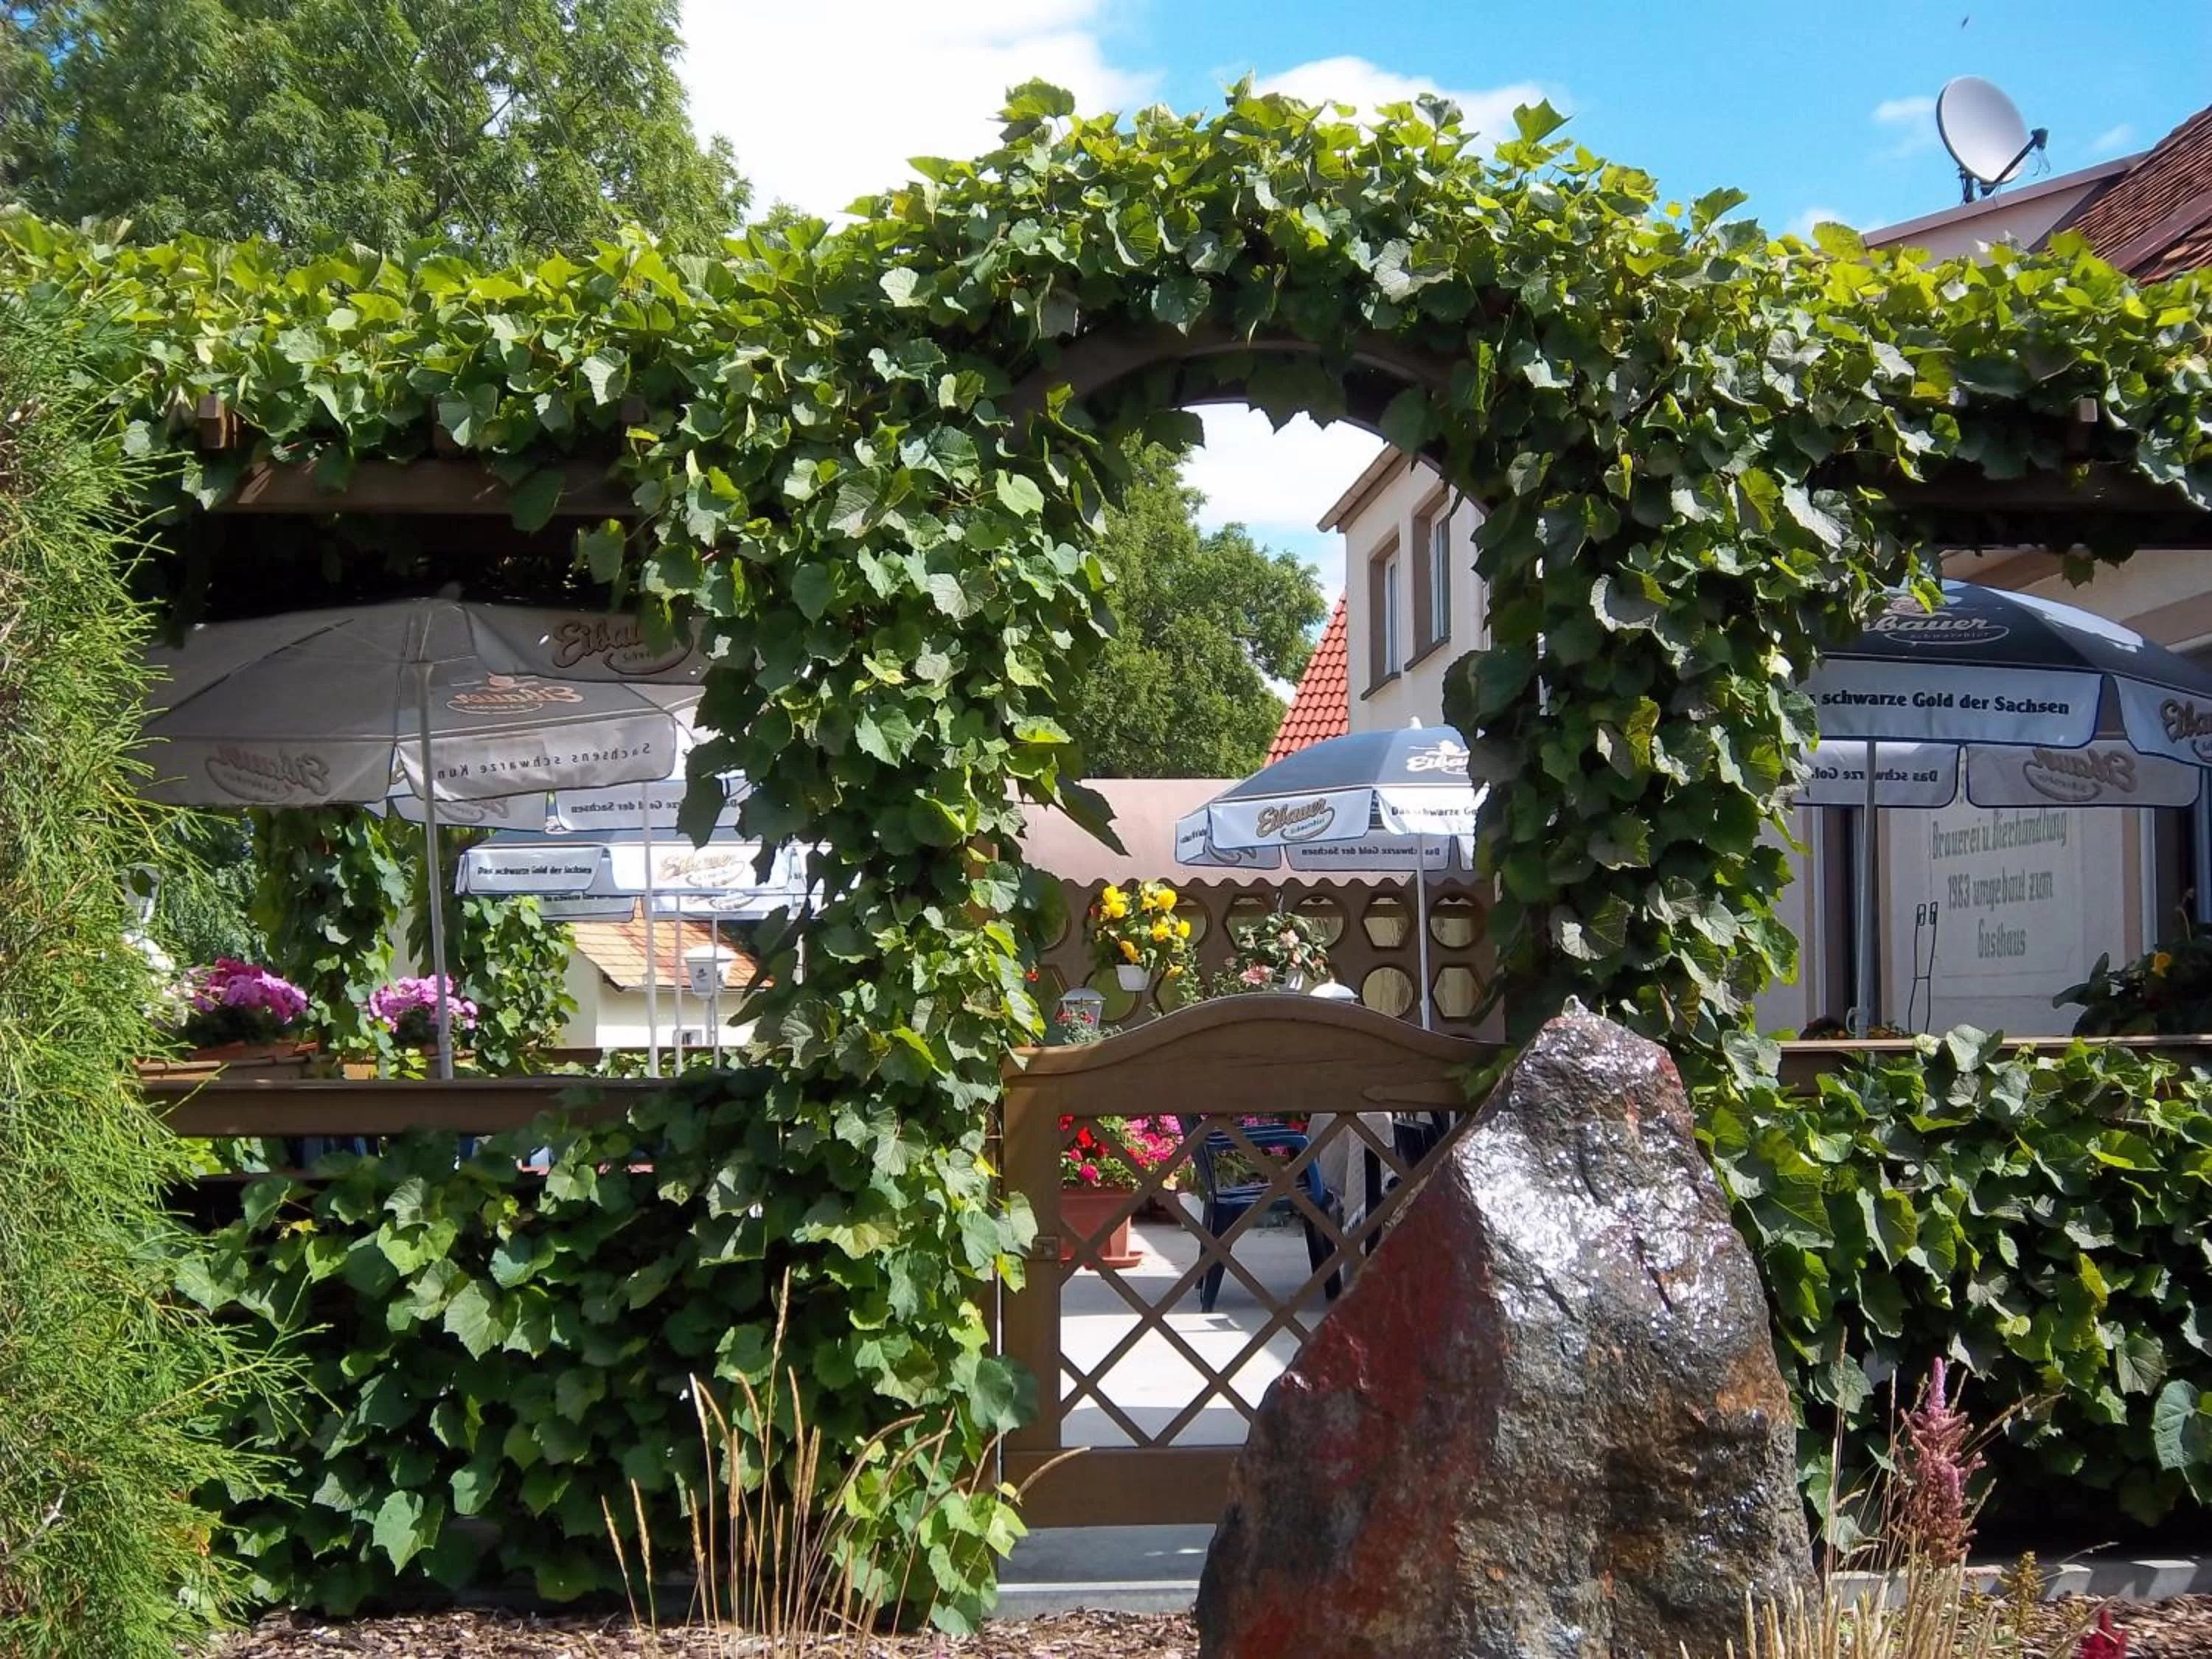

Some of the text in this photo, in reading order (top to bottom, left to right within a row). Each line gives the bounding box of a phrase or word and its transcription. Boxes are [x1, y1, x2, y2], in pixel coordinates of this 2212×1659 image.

[552, 619, 644, 668] Eibau
[1821, 690, 1907, 707] schwarze
[1913, 692, 1953, 708] Gold
[1959, 695, 1989, 710] der
[1994, 696, 2070, 714] Sachsen
[2160, 698, 2212, 743] Eiba
[1256, 797, 1326, 838] Eibauer
[1464, 806, 1476, 815] Go
[1932, 817, 1980, 860] Brauerei
[1992, 809, 2067, 850] Bierhandlung
[1972, 867, 2025, 912] umgebaut
[2029, 871, 2053, 901] zum
[1978, 917, 2026, 959] Gasthaus
